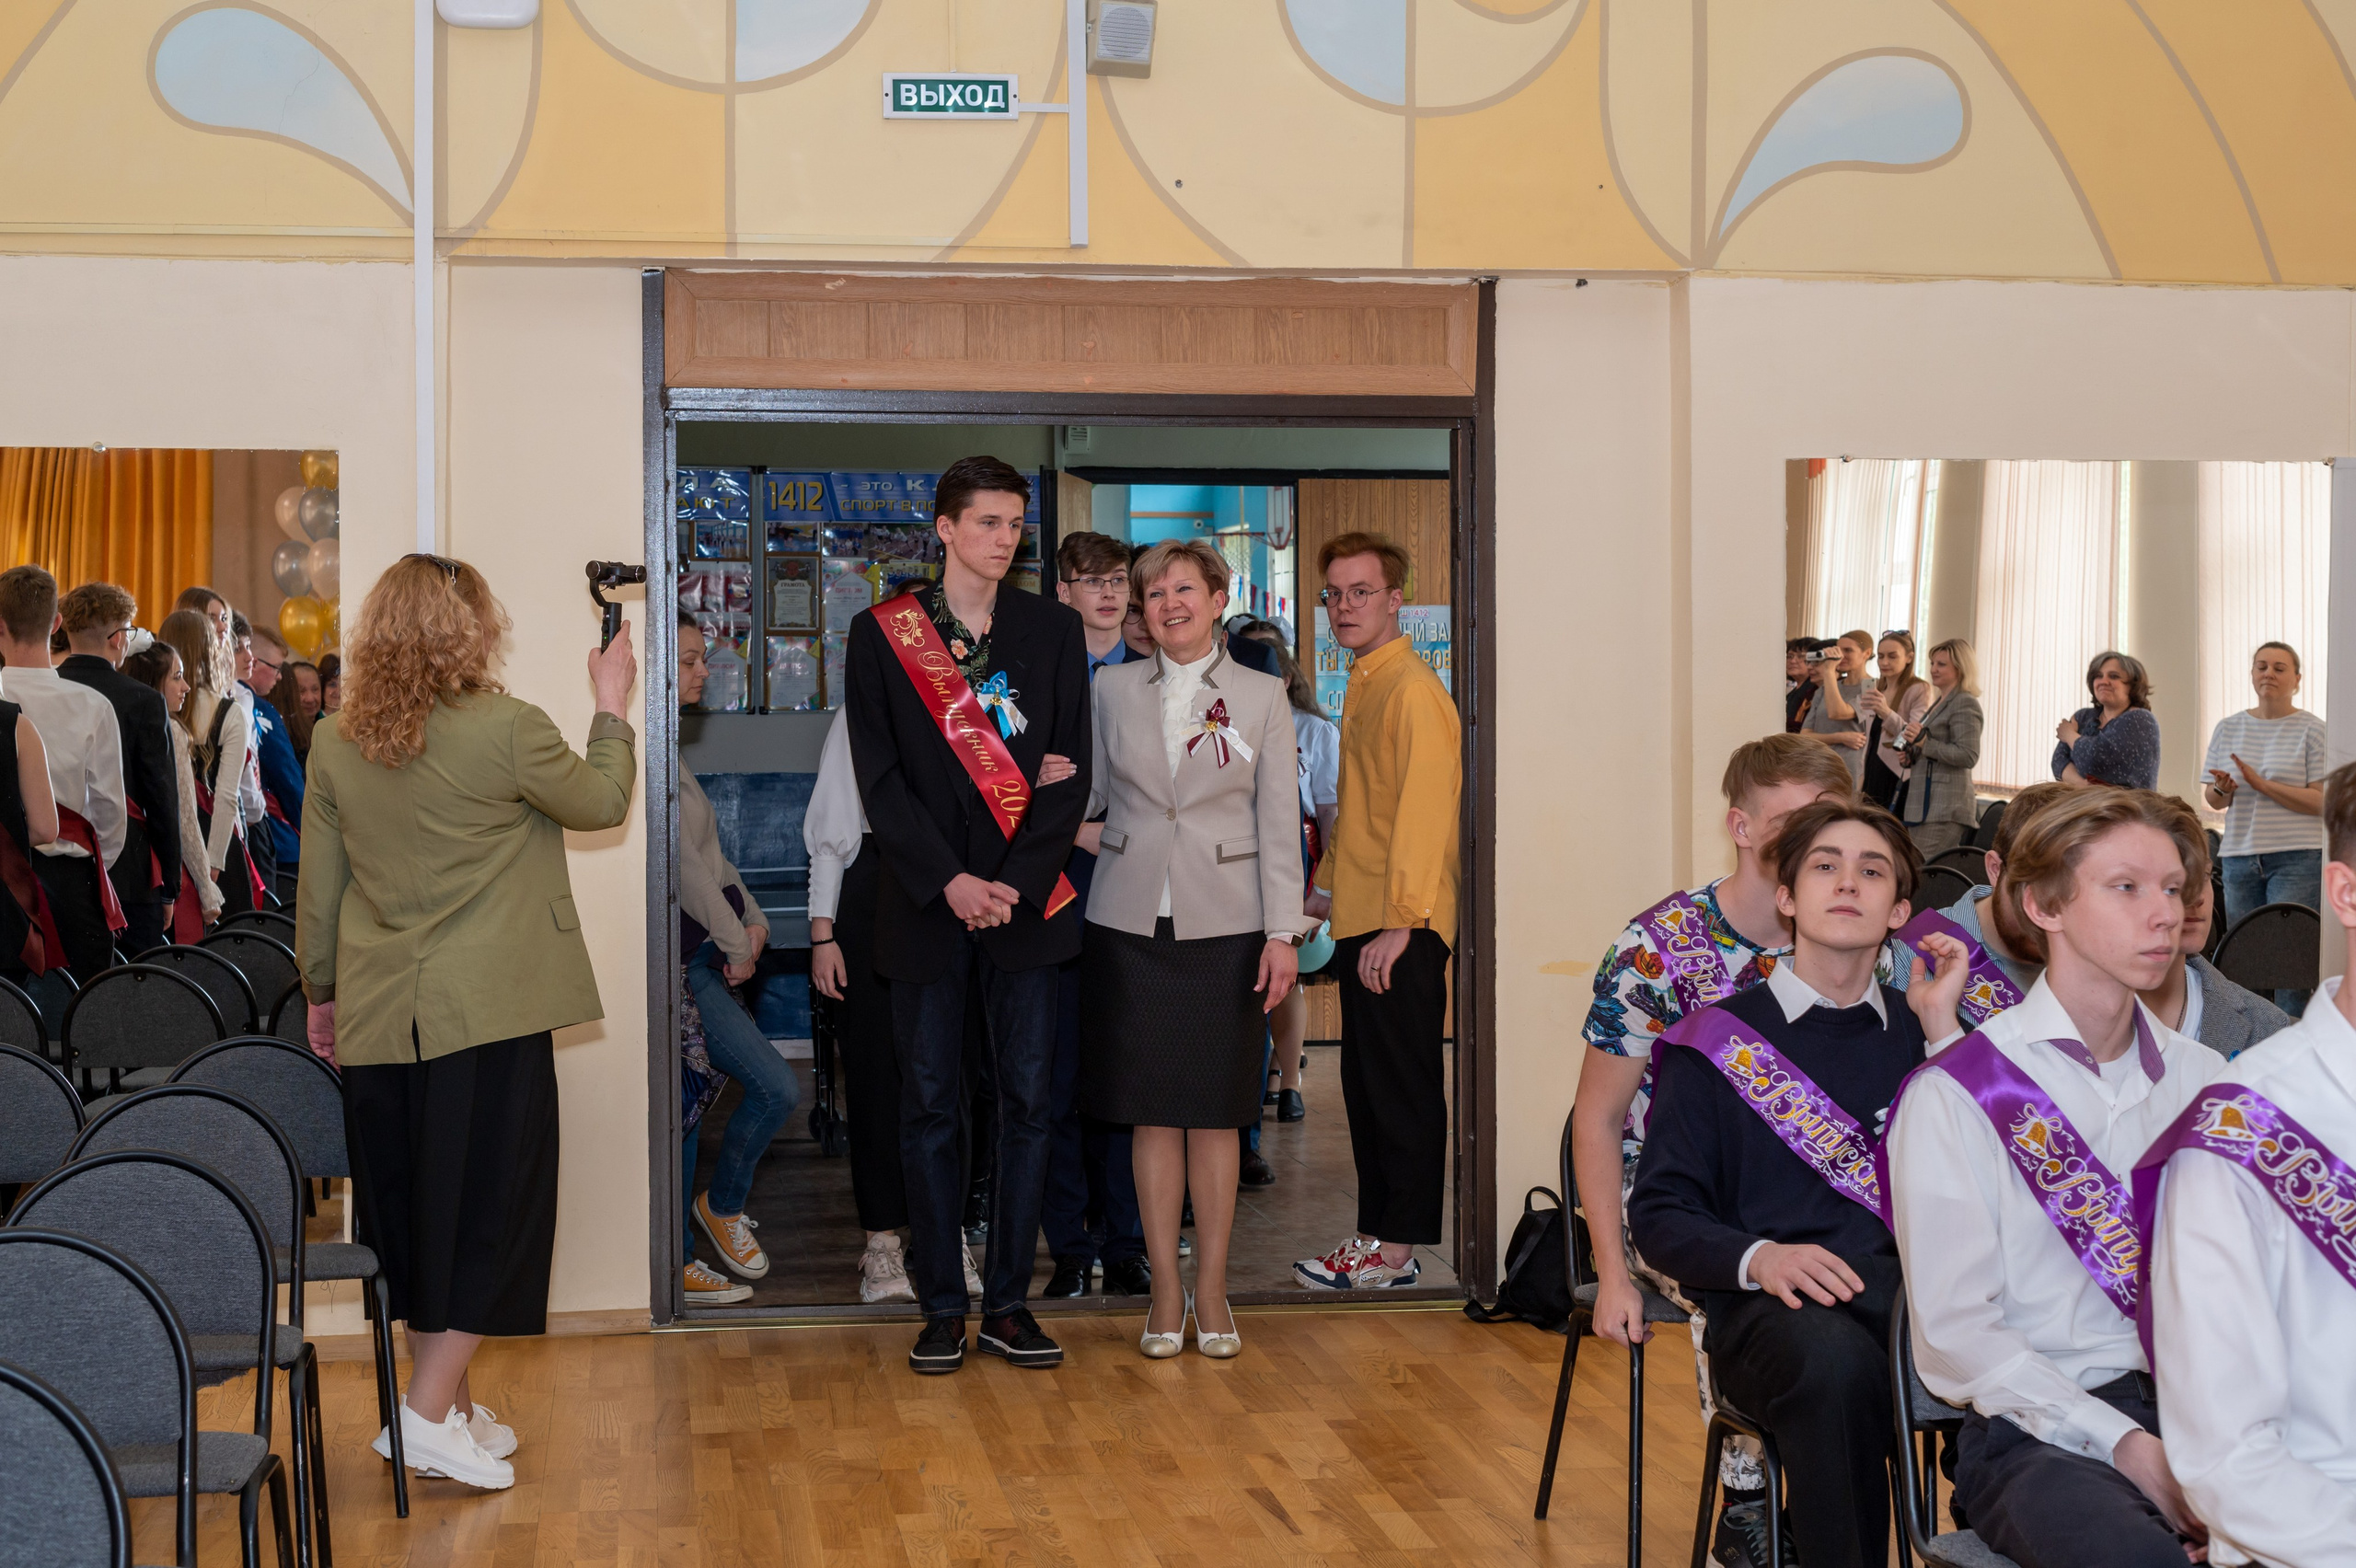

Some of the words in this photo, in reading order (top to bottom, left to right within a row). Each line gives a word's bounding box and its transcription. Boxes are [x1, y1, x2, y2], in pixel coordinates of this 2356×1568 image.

[900, 83, 1005, 108] ВЫХОД
[768, 481, 823, 511] 1412
[840, 500, 896, 512] СПОРТ
[901, 501, 911, 512] В
[1410, 609, 1429, 617] 1412
[1316, 651, 1339, 671] ТЫ
[918, 651, 999, 774] Выпускник
[2036, 1156, 2142, 1299] Выпу
